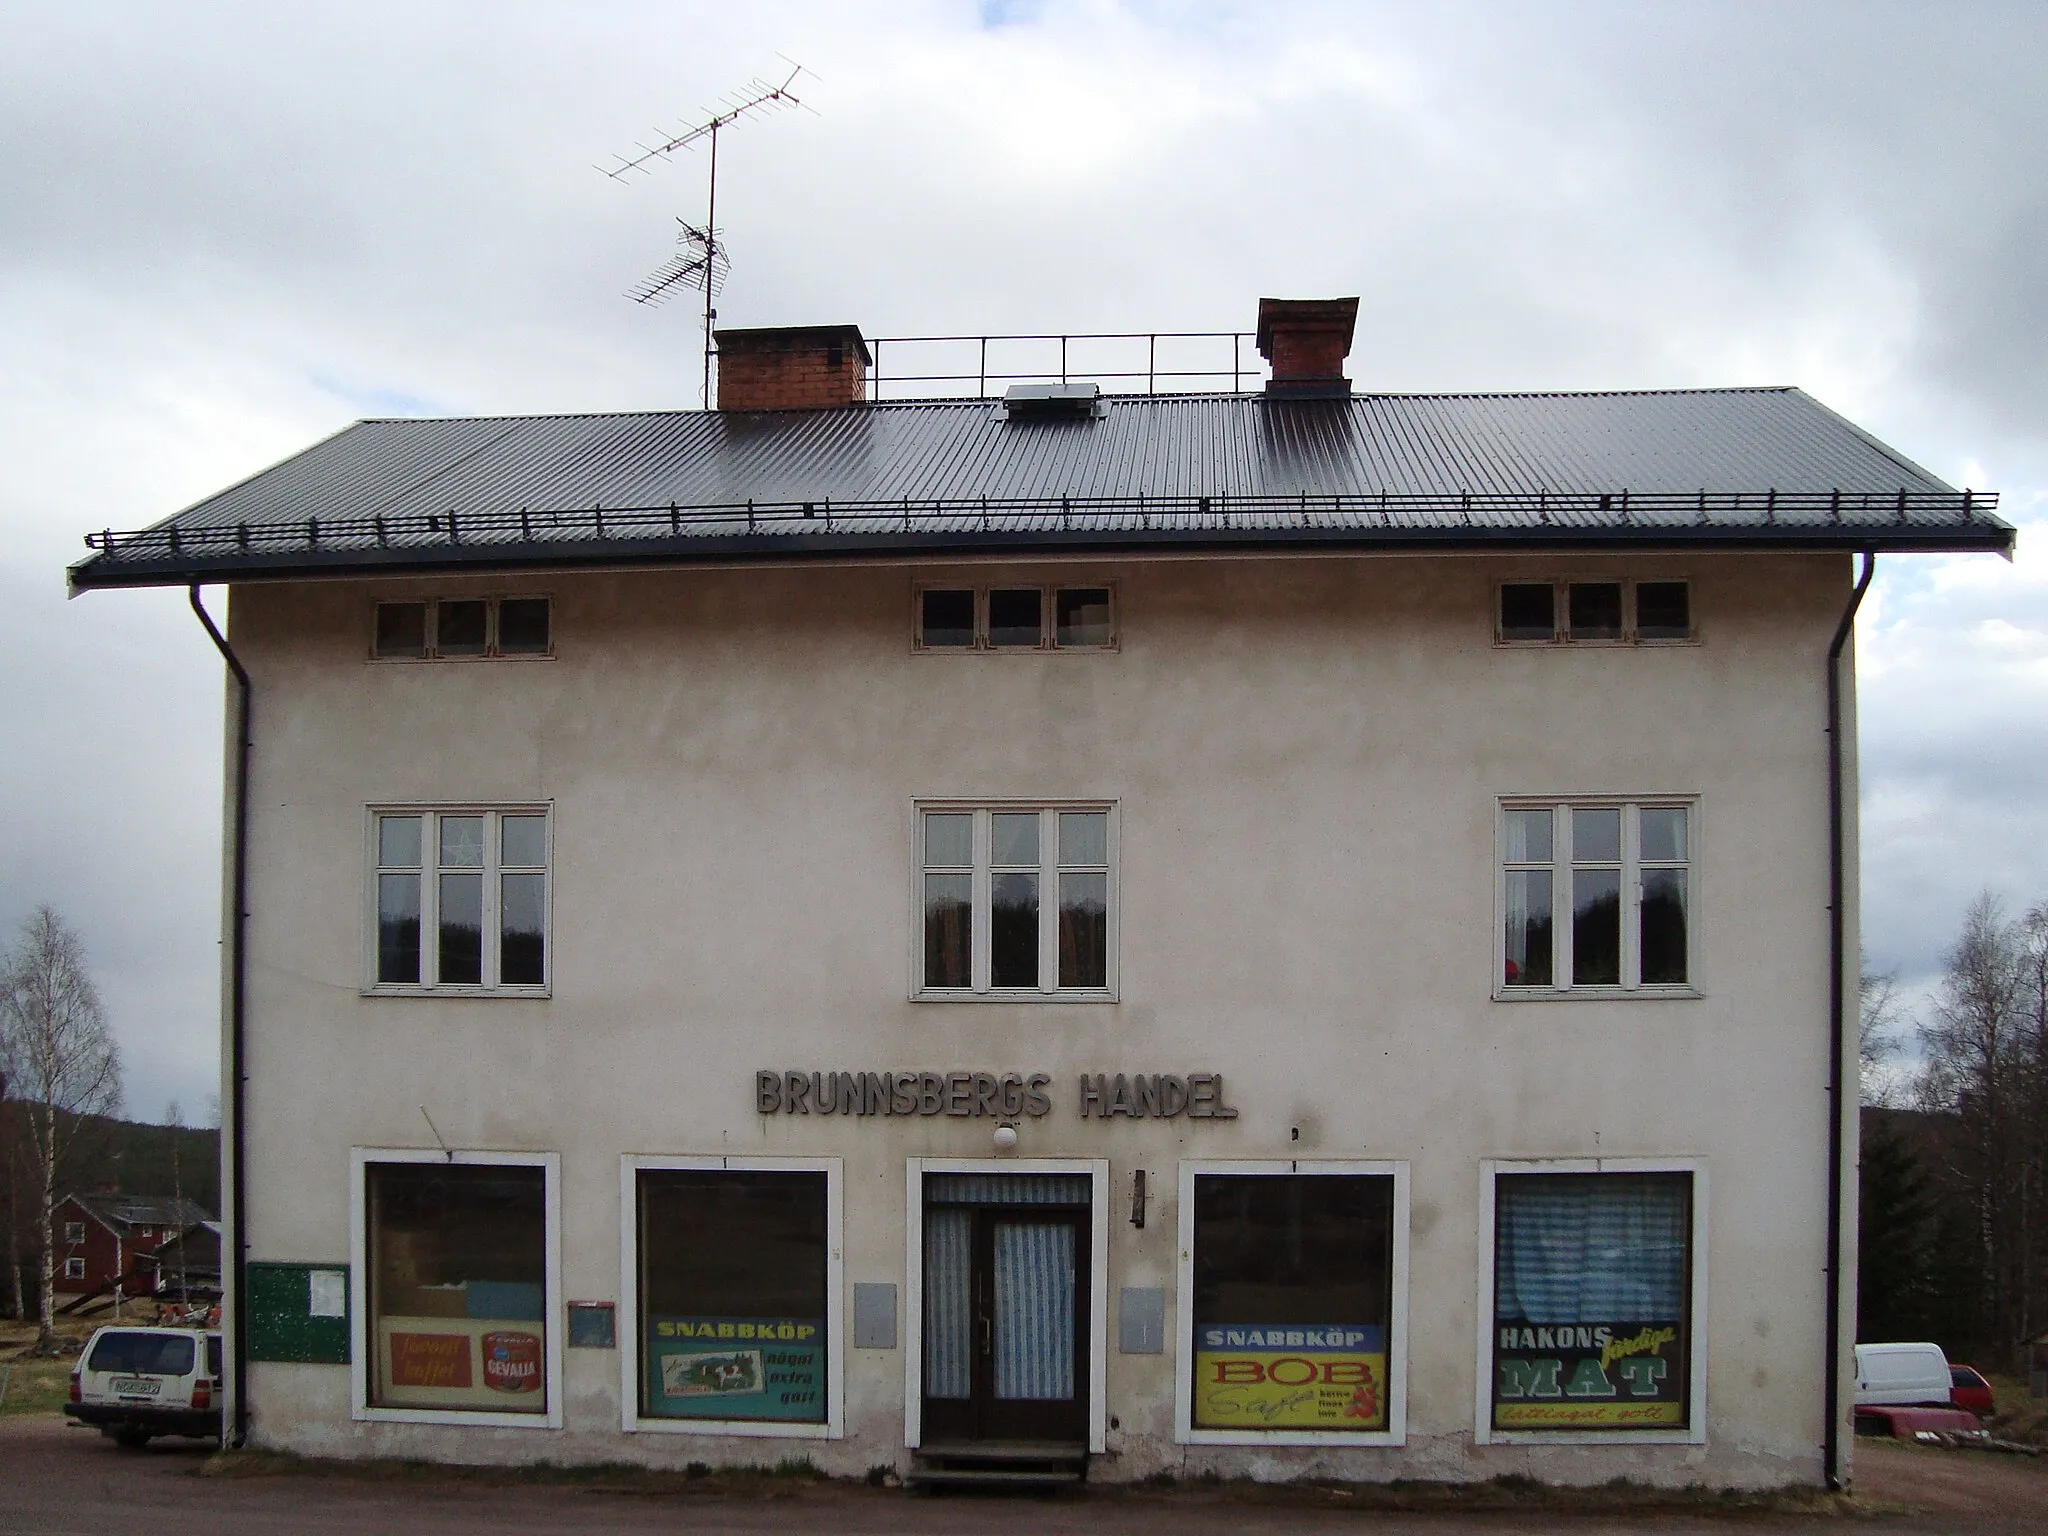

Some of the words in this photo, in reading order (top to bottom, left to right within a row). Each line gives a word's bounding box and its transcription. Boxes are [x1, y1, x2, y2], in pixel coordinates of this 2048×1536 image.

[756, 1070, 1052, 1117] BRUNNSBERGS
[1080, 1072, 1238, 1119] HANDEL
[657, 1321, 816, 1340] SNABBKÖP
[1205, 1328, 1365, 1347] SNABBKÖP
[1500, 1326, 1612, 1349] HAKONS
[1211, 1358, 1373, 1386] BOB
[1500, 1359, 1667, 1397] MAT
